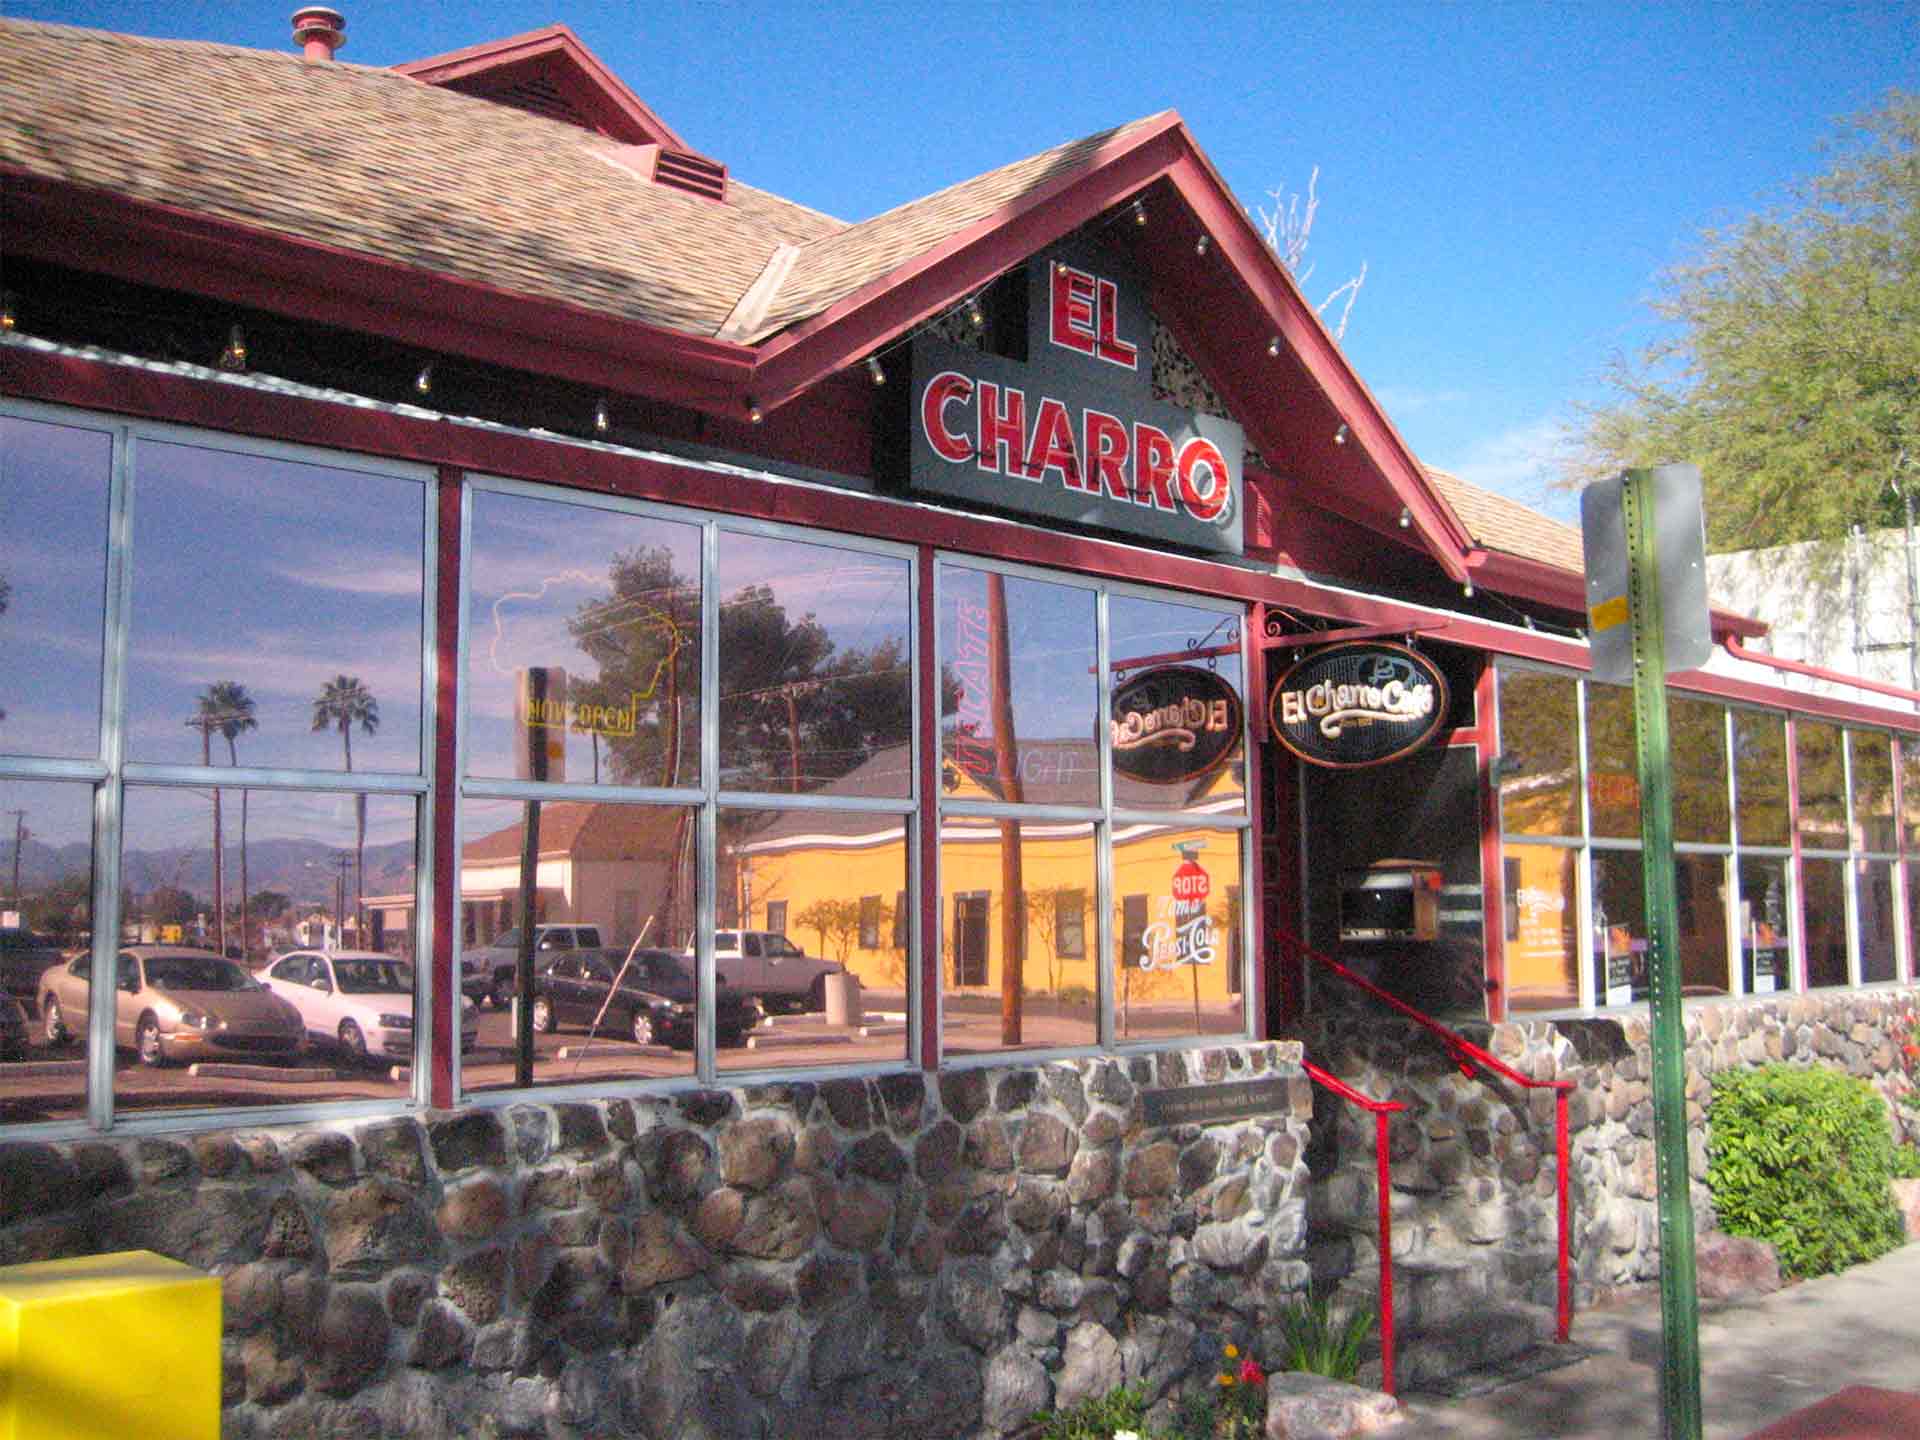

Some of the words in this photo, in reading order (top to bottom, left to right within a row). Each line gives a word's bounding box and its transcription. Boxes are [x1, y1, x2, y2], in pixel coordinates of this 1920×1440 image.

[1049, 260, 1137, 370] EL
[922, 371, 1230, 521] CHARRO
[1282, 690, 1307, 724] El
[1307, 679, 1382, 716] Charro
